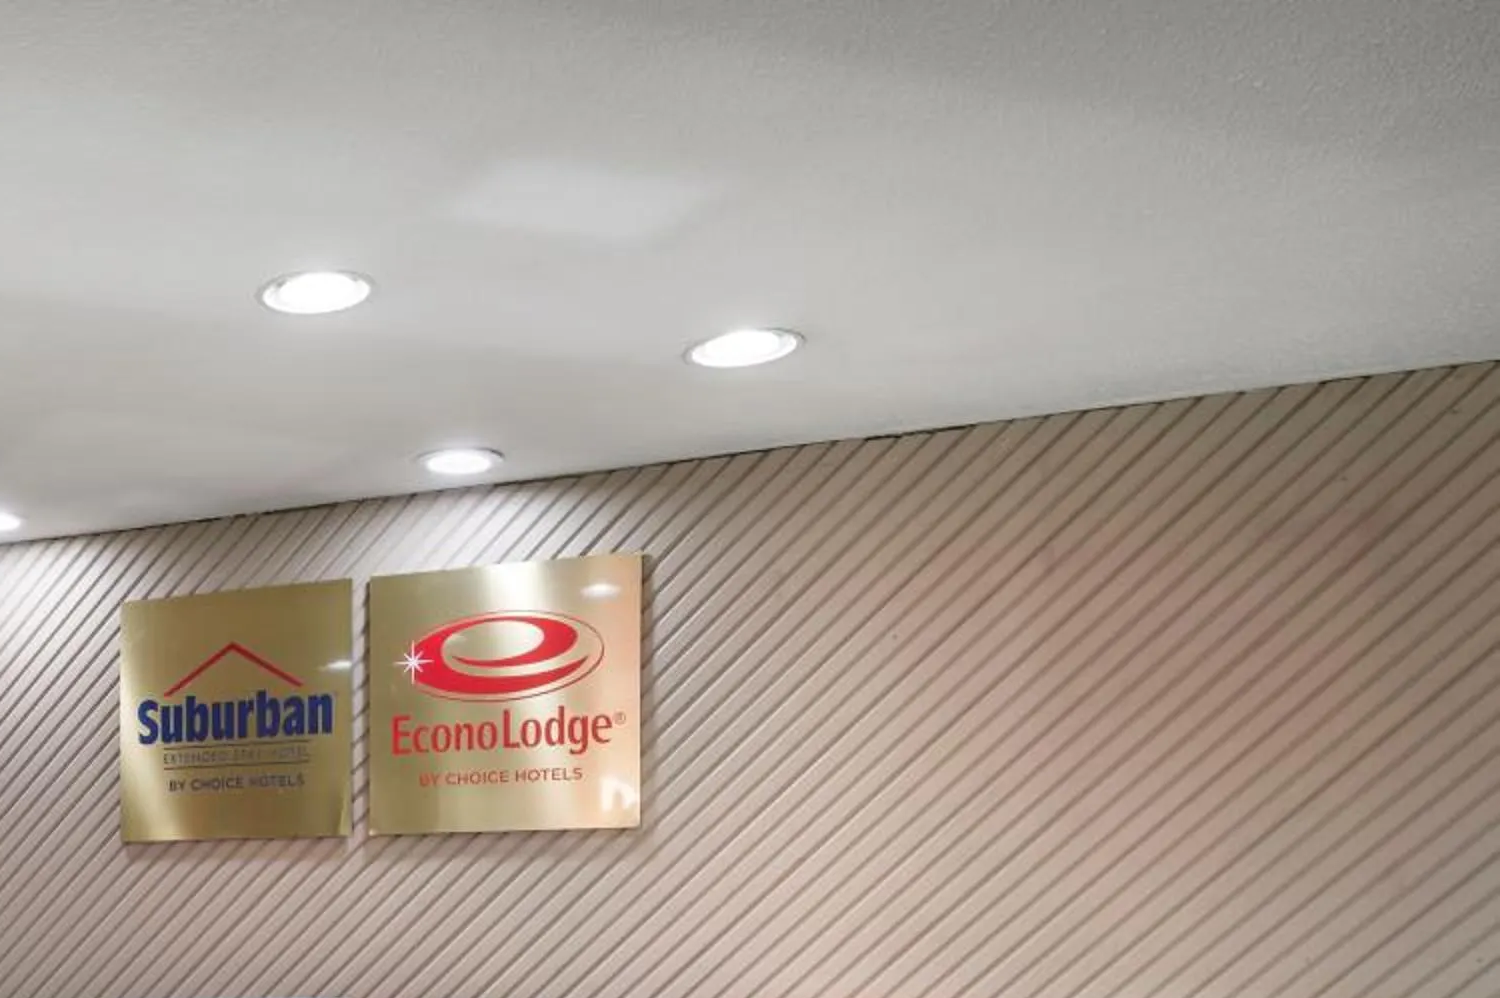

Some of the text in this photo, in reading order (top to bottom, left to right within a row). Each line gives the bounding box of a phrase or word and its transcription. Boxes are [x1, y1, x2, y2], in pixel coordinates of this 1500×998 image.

[137, 689, 333, 745] Suburban
[168, 773, 306, 792] BY CHOICE HOTELS
[419, 767, 583, 788] BY CHOICE HOTELS
